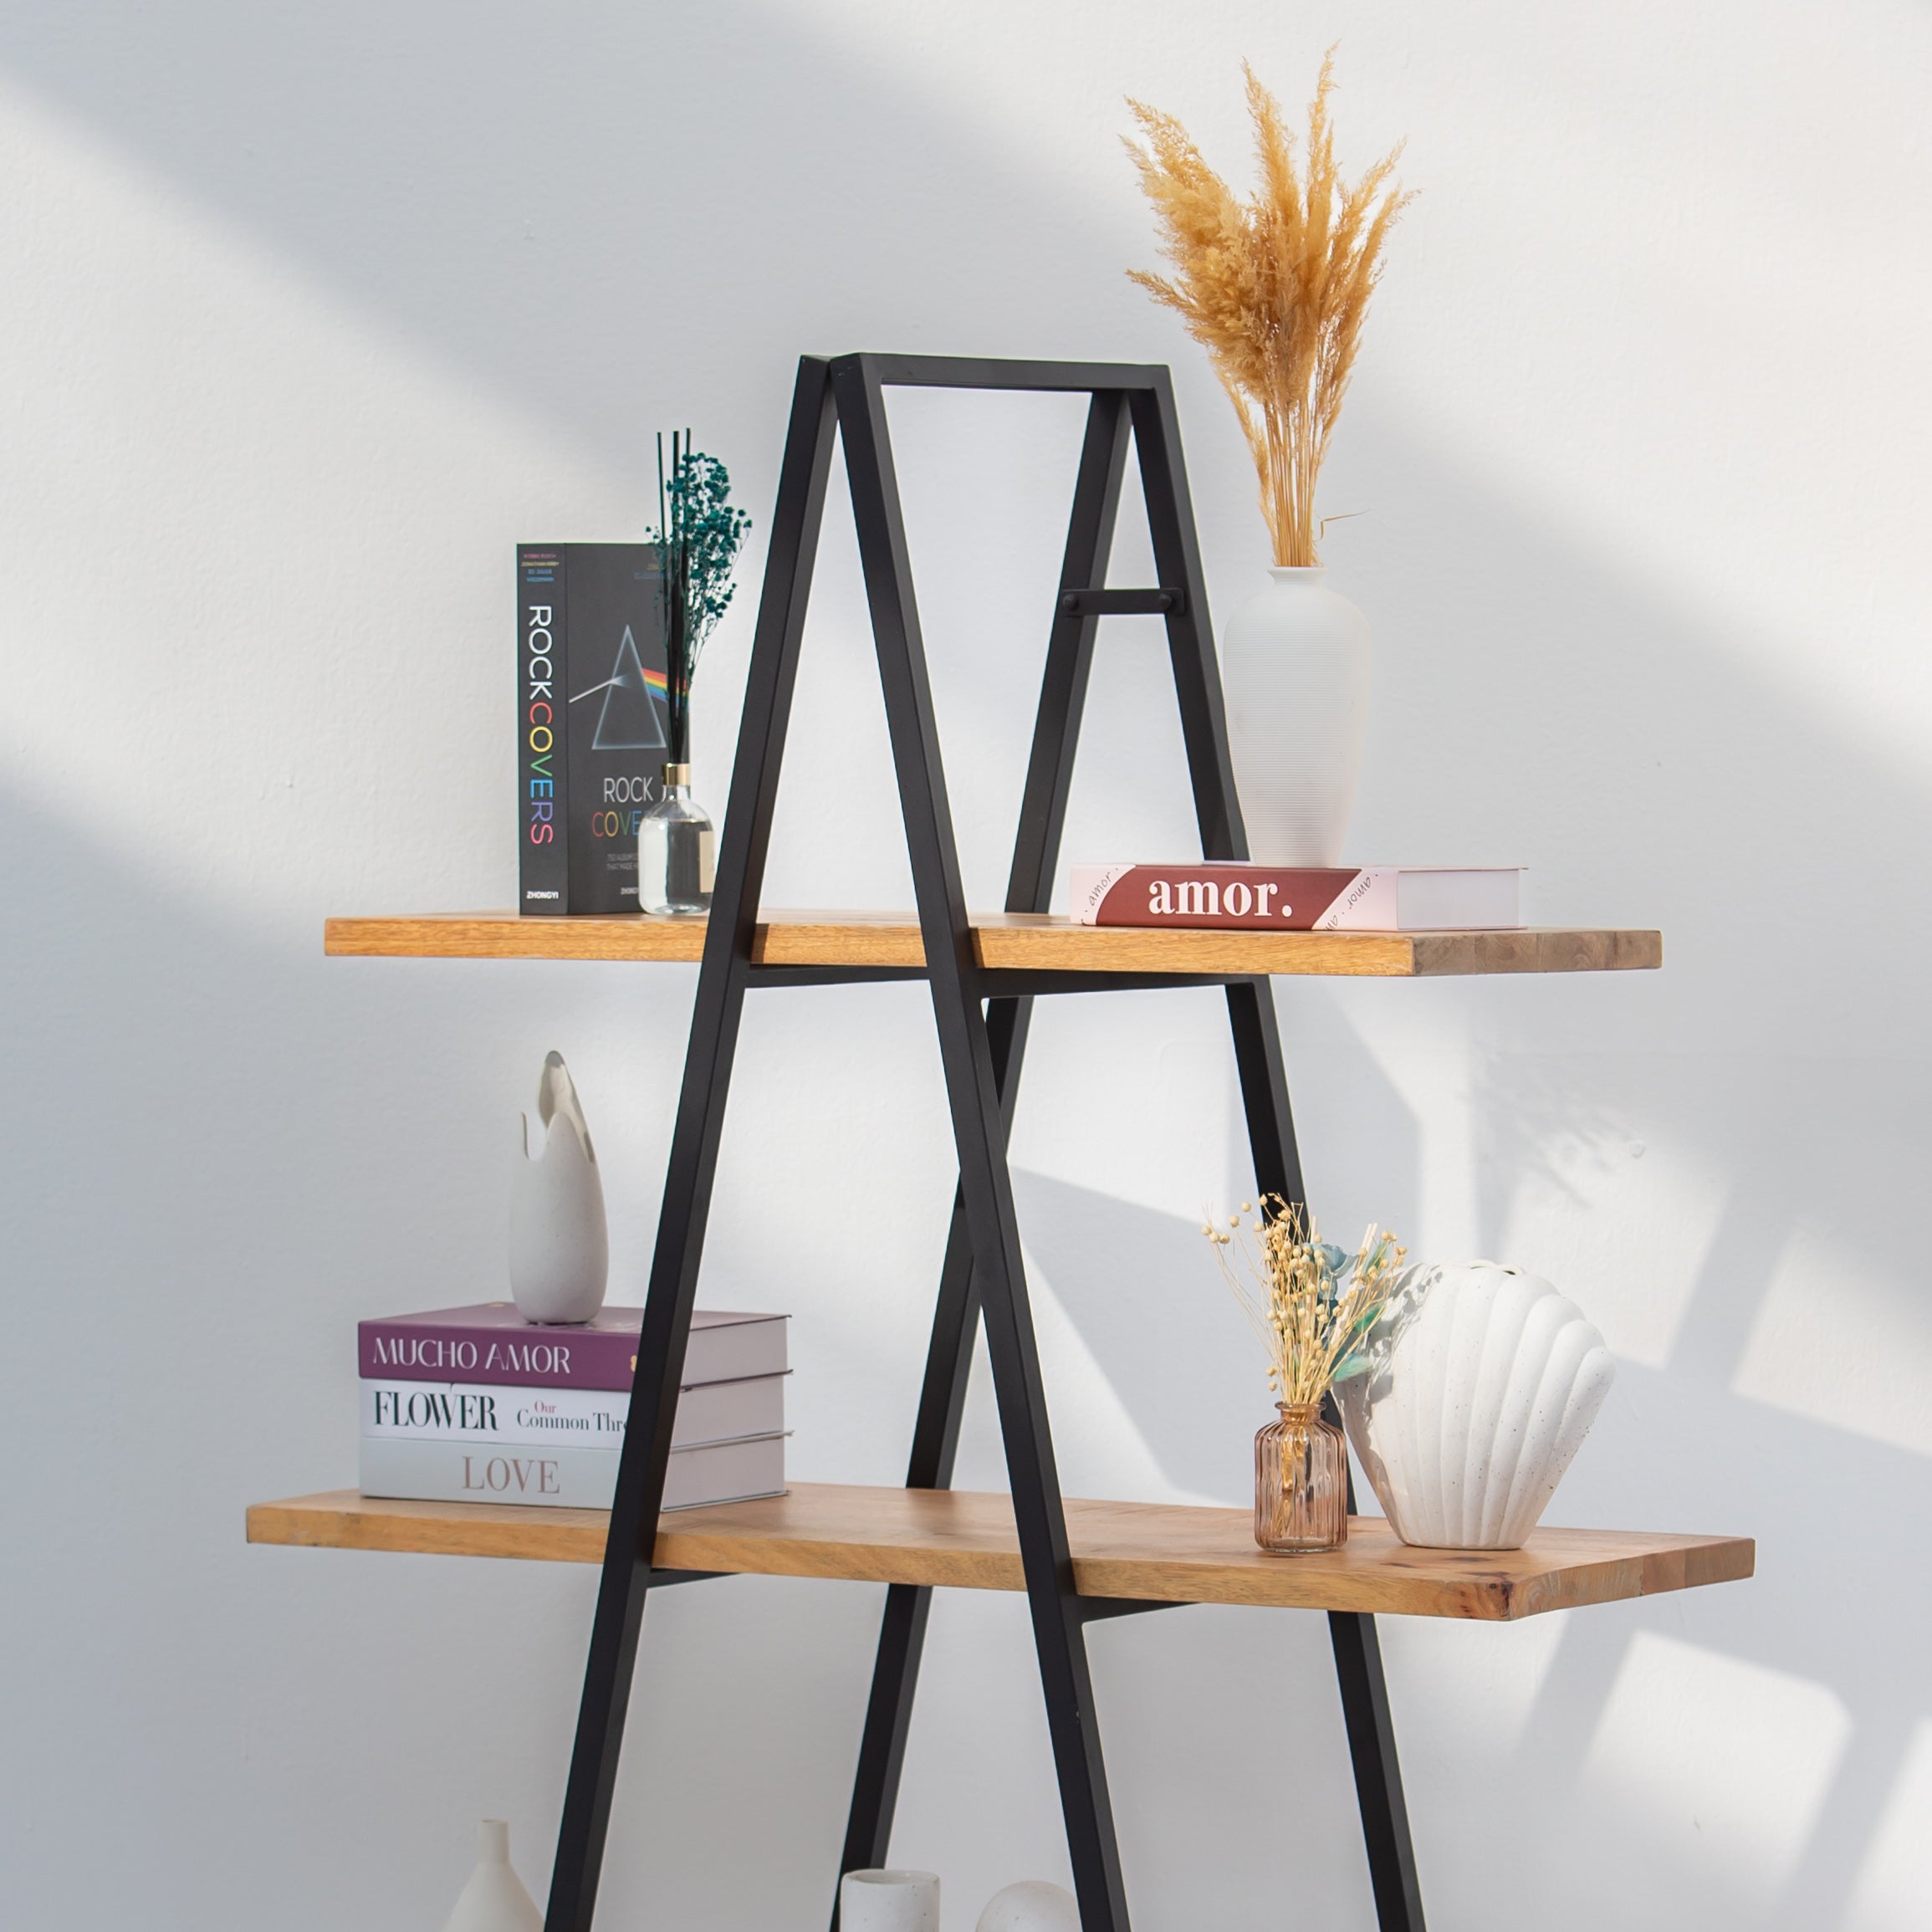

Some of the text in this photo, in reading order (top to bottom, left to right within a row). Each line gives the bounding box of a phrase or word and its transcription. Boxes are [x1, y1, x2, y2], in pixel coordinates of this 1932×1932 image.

[529, 606, 554, 845] ROCKCOVERS
[604, 776, 654, 803] ROCK
[591, 810, 643, 837] COVE
[1088, 871, 1112, 906] amor
[1148, 880, 1293, 917] amor.
[1347, 877, 1372, 910] amor
[373, 1337, 570, 1374] MUCHO AMOR
[373, 1391, 501, 1431] FLOWER
[517, 1408, 590, 1431] Common
[534, 1400, 557, 1413] Our
[462, 1456, 560, 1494] LOVE
